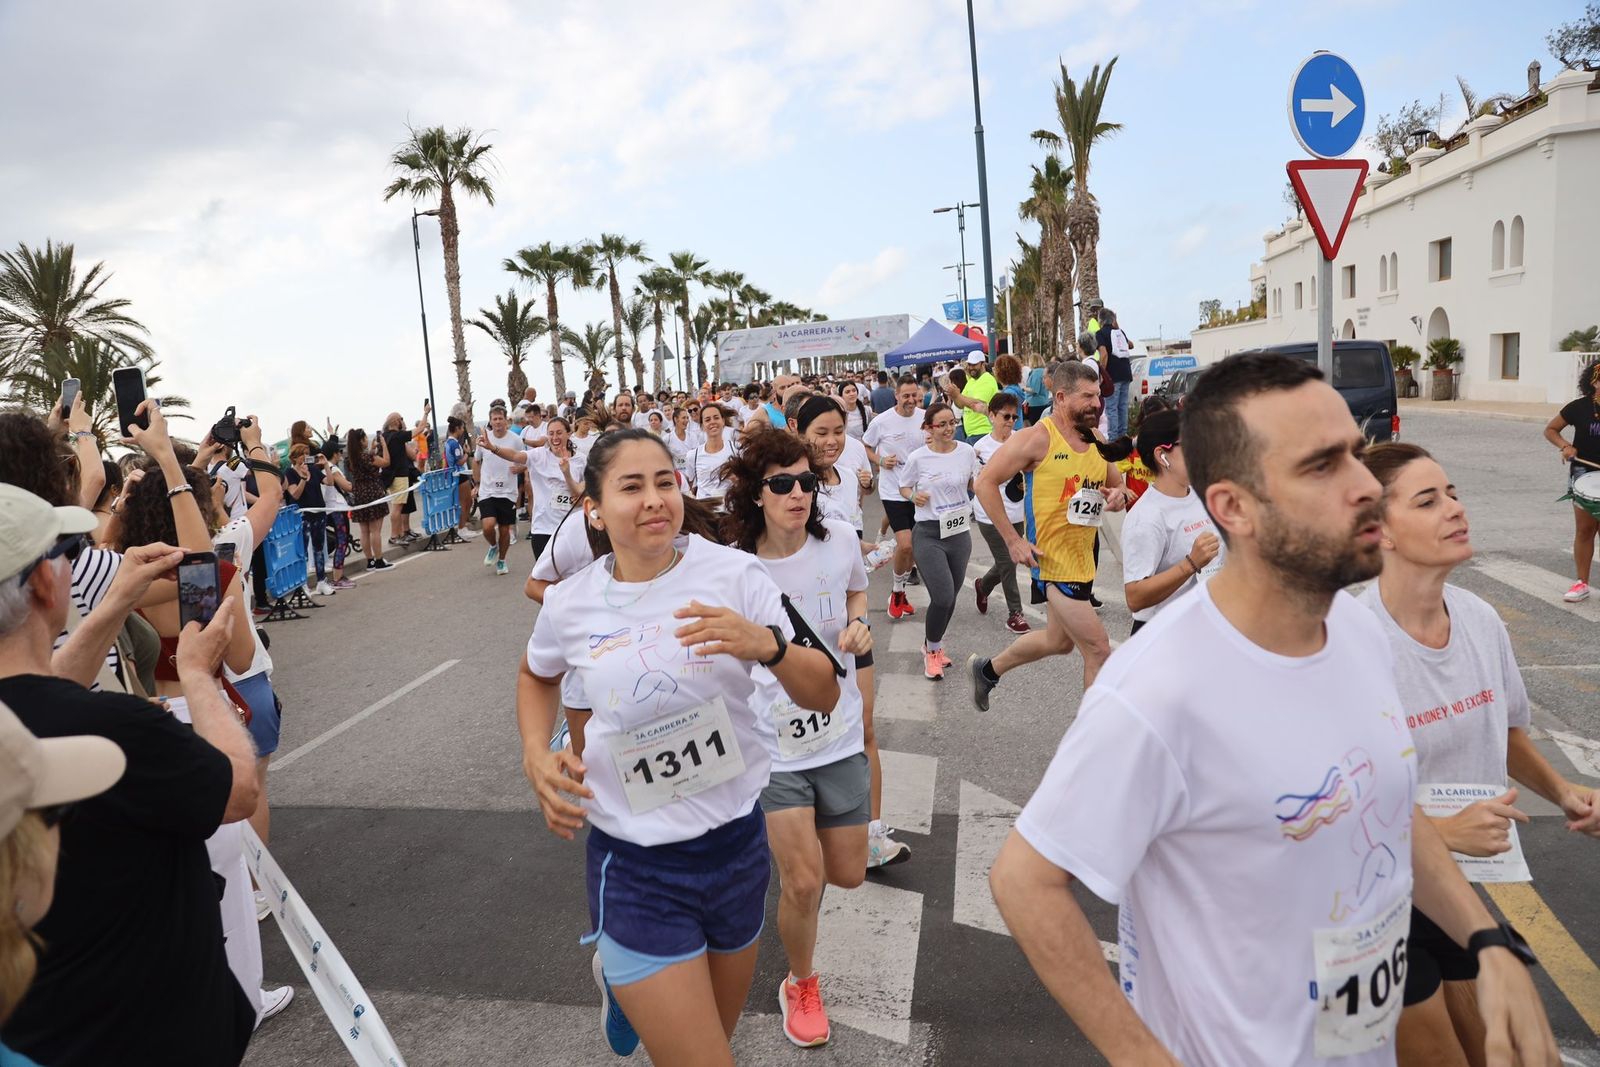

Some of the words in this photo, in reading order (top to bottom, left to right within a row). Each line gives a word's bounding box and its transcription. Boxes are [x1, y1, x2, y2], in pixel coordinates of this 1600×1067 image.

[790, 326, 833, 338] CARRERA
[834, 325, 847, 334] 5K
[1054, 452, 1069, 460] vive
[946, 516, 965, 530] 992
[1452, 701, 1464, 714] NO
[647, 717, 687, 737] CARRERA
[633, 730, 726, 784] 1311
[1445, 788, 1487, 797] CARRERA
